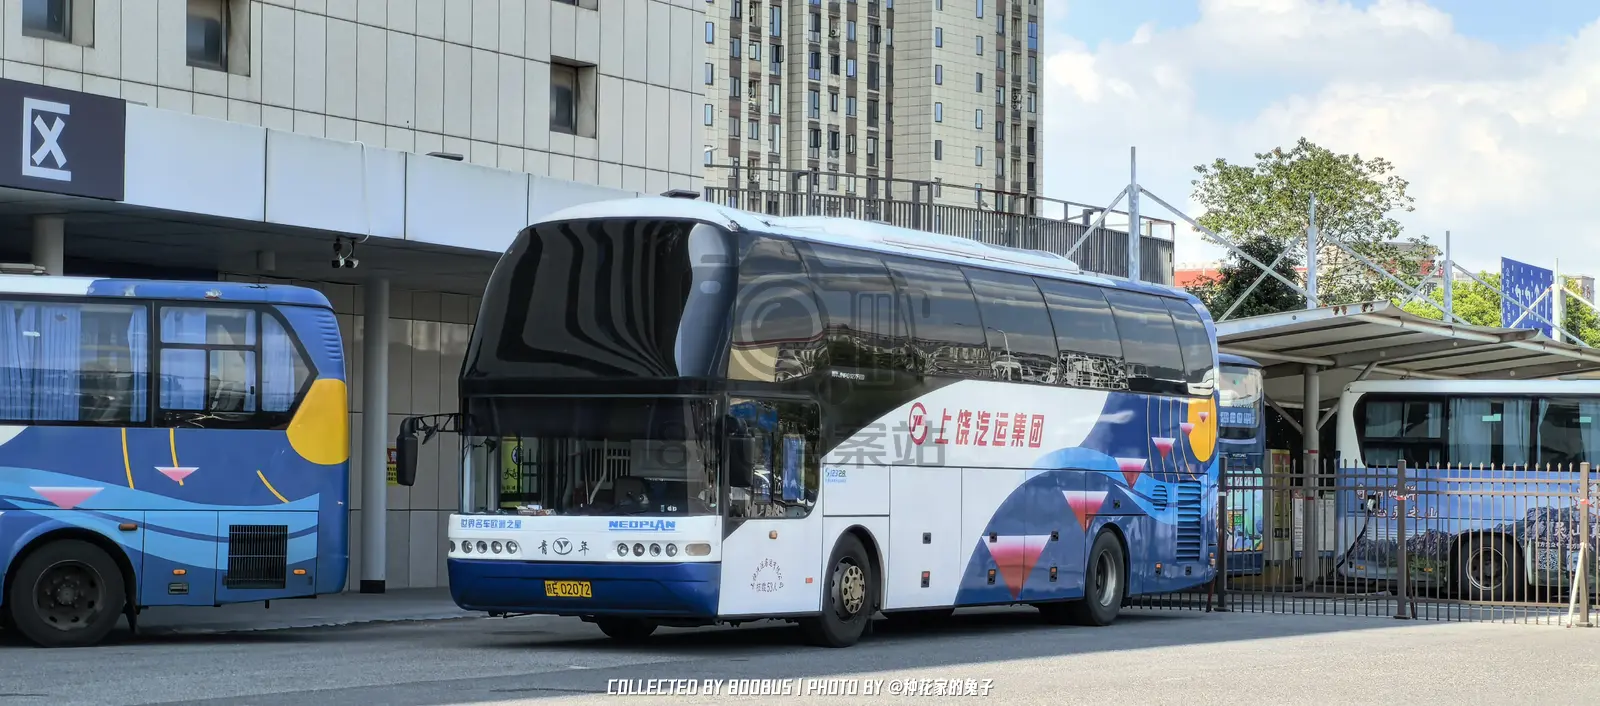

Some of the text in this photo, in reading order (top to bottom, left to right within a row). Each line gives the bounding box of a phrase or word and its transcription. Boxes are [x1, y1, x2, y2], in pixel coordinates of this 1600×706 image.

[934, 407, 1045, 449] 上饶汽运集团
[608, 519, 676, 531] NEOPLAN
